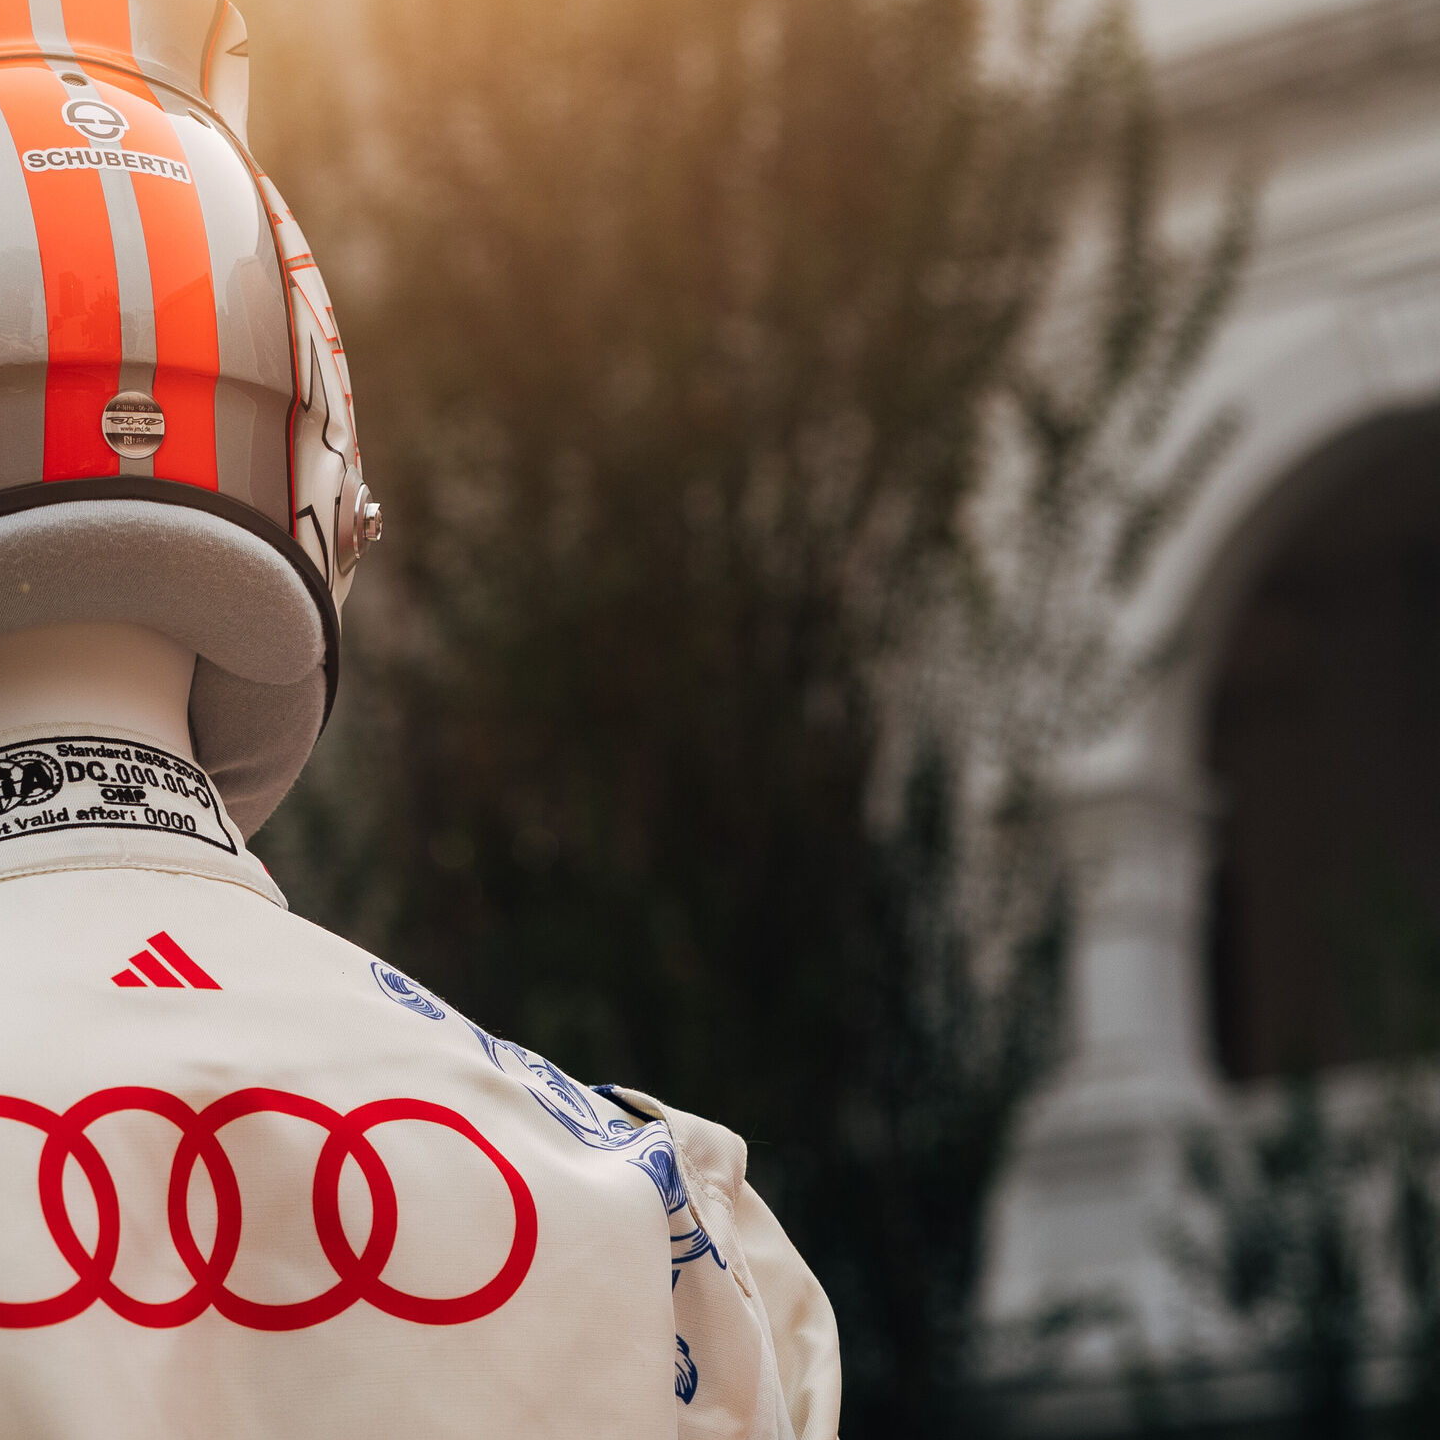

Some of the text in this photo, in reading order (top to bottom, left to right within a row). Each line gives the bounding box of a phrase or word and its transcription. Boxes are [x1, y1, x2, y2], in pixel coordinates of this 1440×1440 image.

[27, 150, 188, 180] SCHUBERTH
[56, 744, 132, 761] Standard
[100, 788, 147, 803] OMP
[76, 806, 137, 821] after:
[144, 807, 197, 832] 0000
